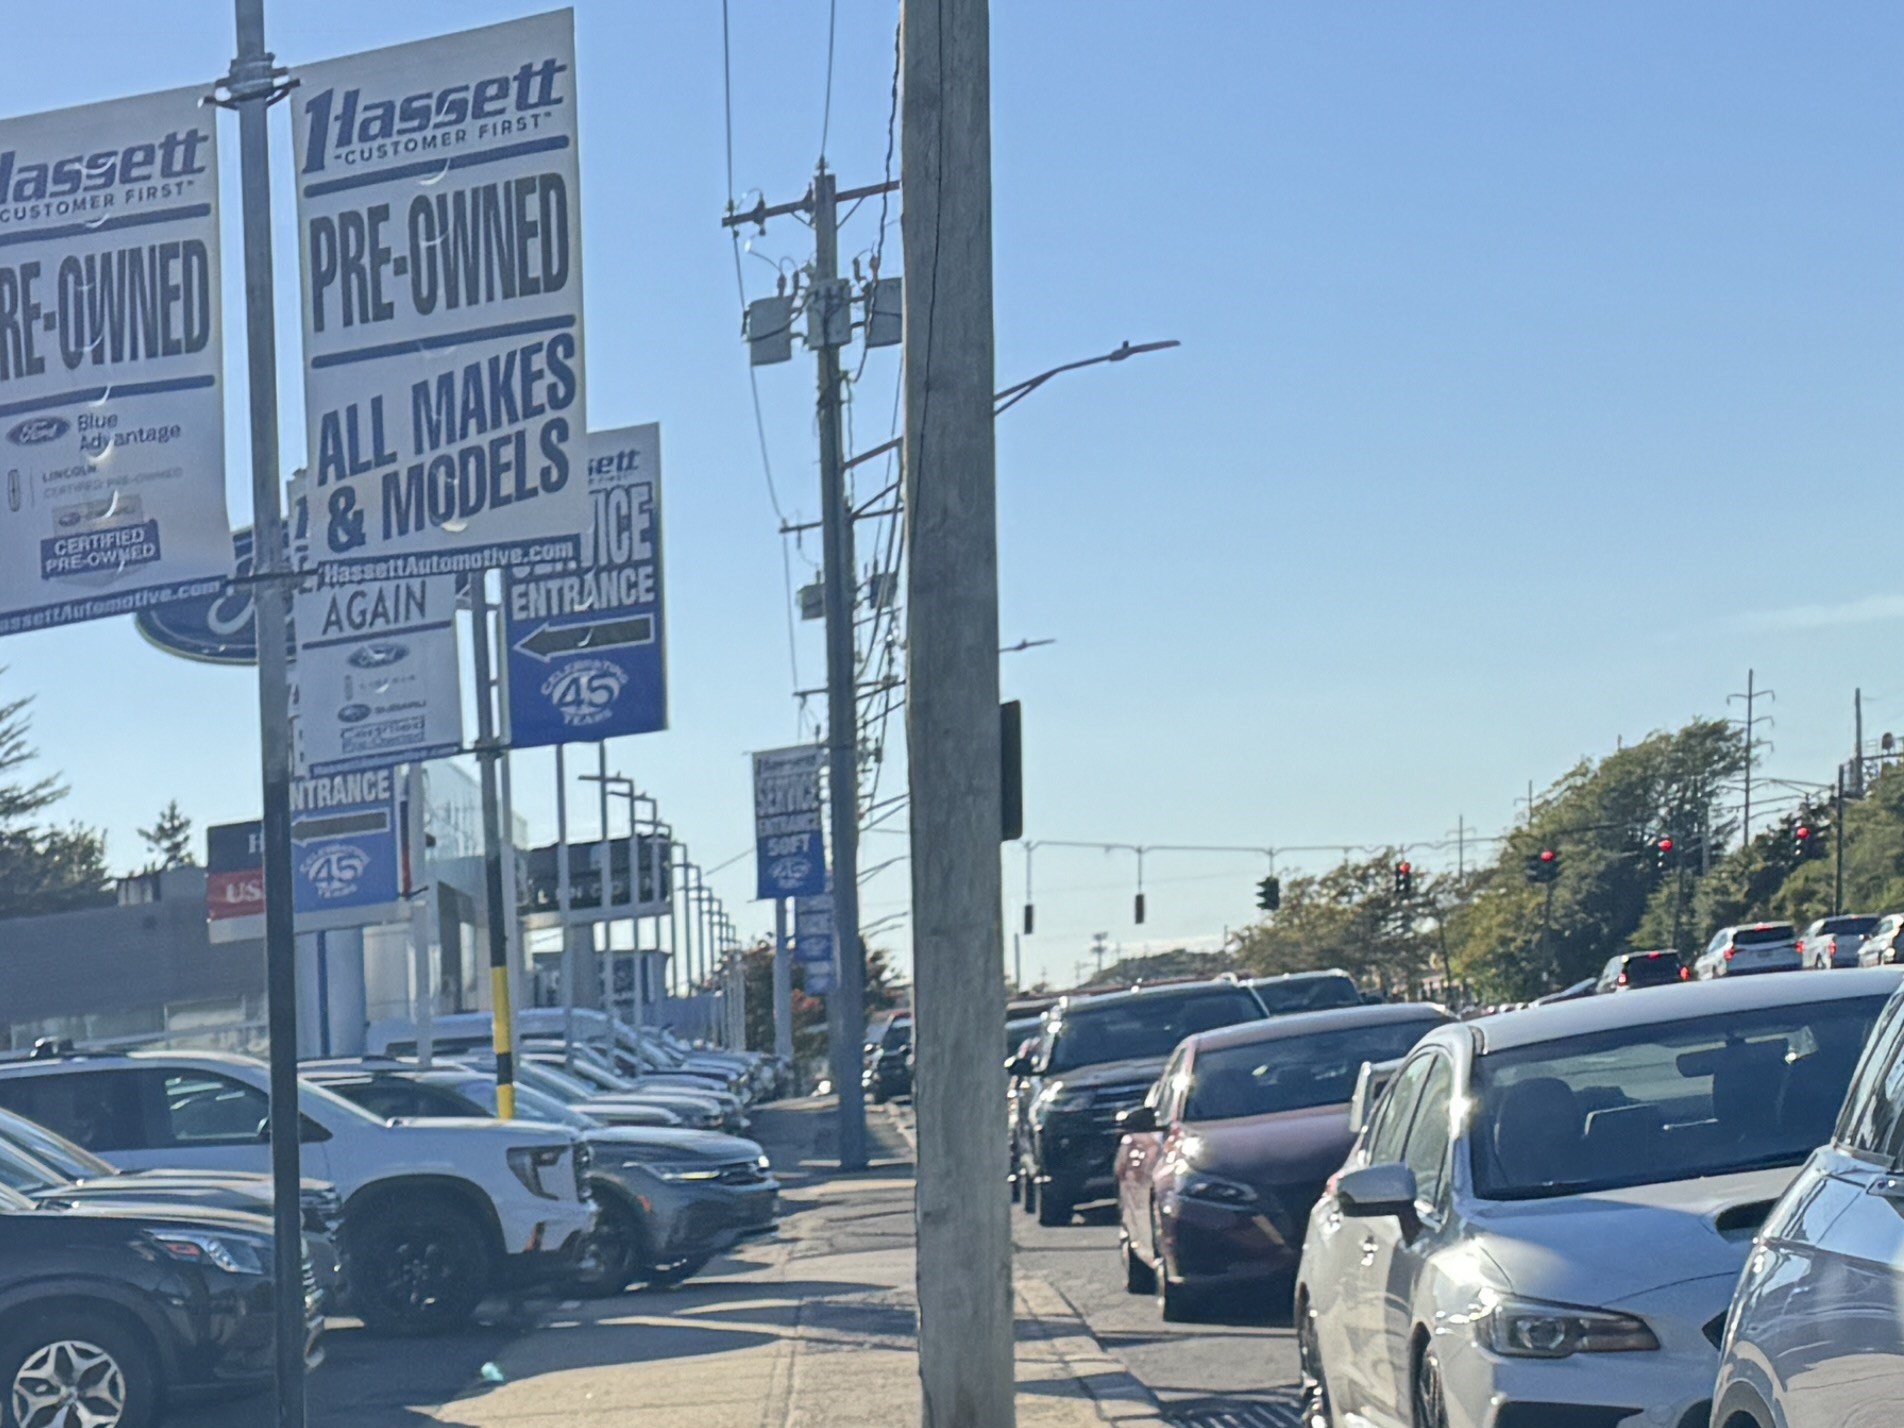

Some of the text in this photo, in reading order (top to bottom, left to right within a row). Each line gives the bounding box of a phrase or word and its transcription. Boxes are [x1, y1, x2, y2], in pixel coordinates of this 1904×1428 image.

[309, 172, 569, 333] PRE-OWNED
[78, 412, 118, 433] Blue
[318, 332, 576, 487] ALL MAKES
[80, 424, 181, 452] Advantage
[328, 486, 365, 553] &
[382, 417, 569, 541] MODELS
[46, 542, 156, 573] PRE-OWNED
[55, 527, 144, 556] CERTIFIED
[324, 540, 573, 584] HassettAutomotive.com
[322, 579, 426, 636] AGAIN
[511, 565, 656, 620] ENTRANCE
[552, 670, 620, 709] 45
[289, 769, 390, 811] NTRANCE
